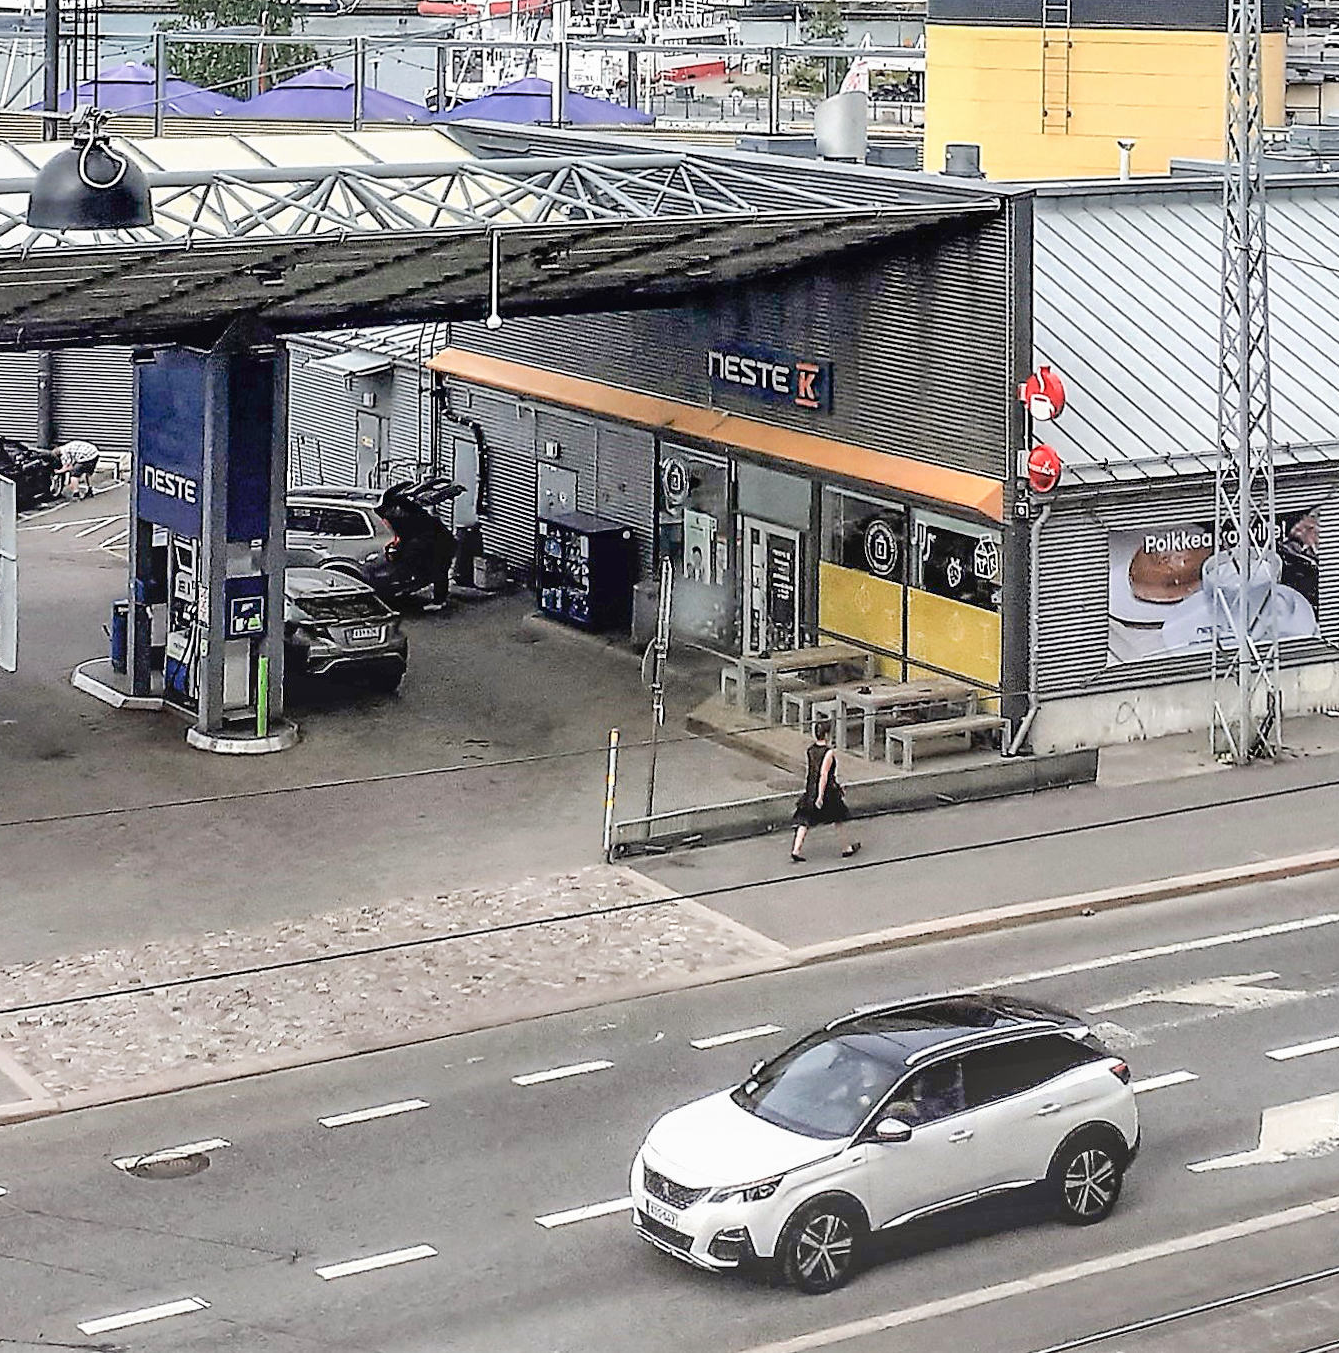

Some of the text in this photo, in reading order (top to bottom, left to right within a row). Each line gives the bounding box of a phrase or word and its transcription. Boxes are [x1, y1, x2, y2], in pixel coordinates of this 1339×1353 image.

[708, 351, 790, 393] NESTE
[144, 465, 197, 504] NESTE
[1145, 531, 1213, 554] Poikkea
